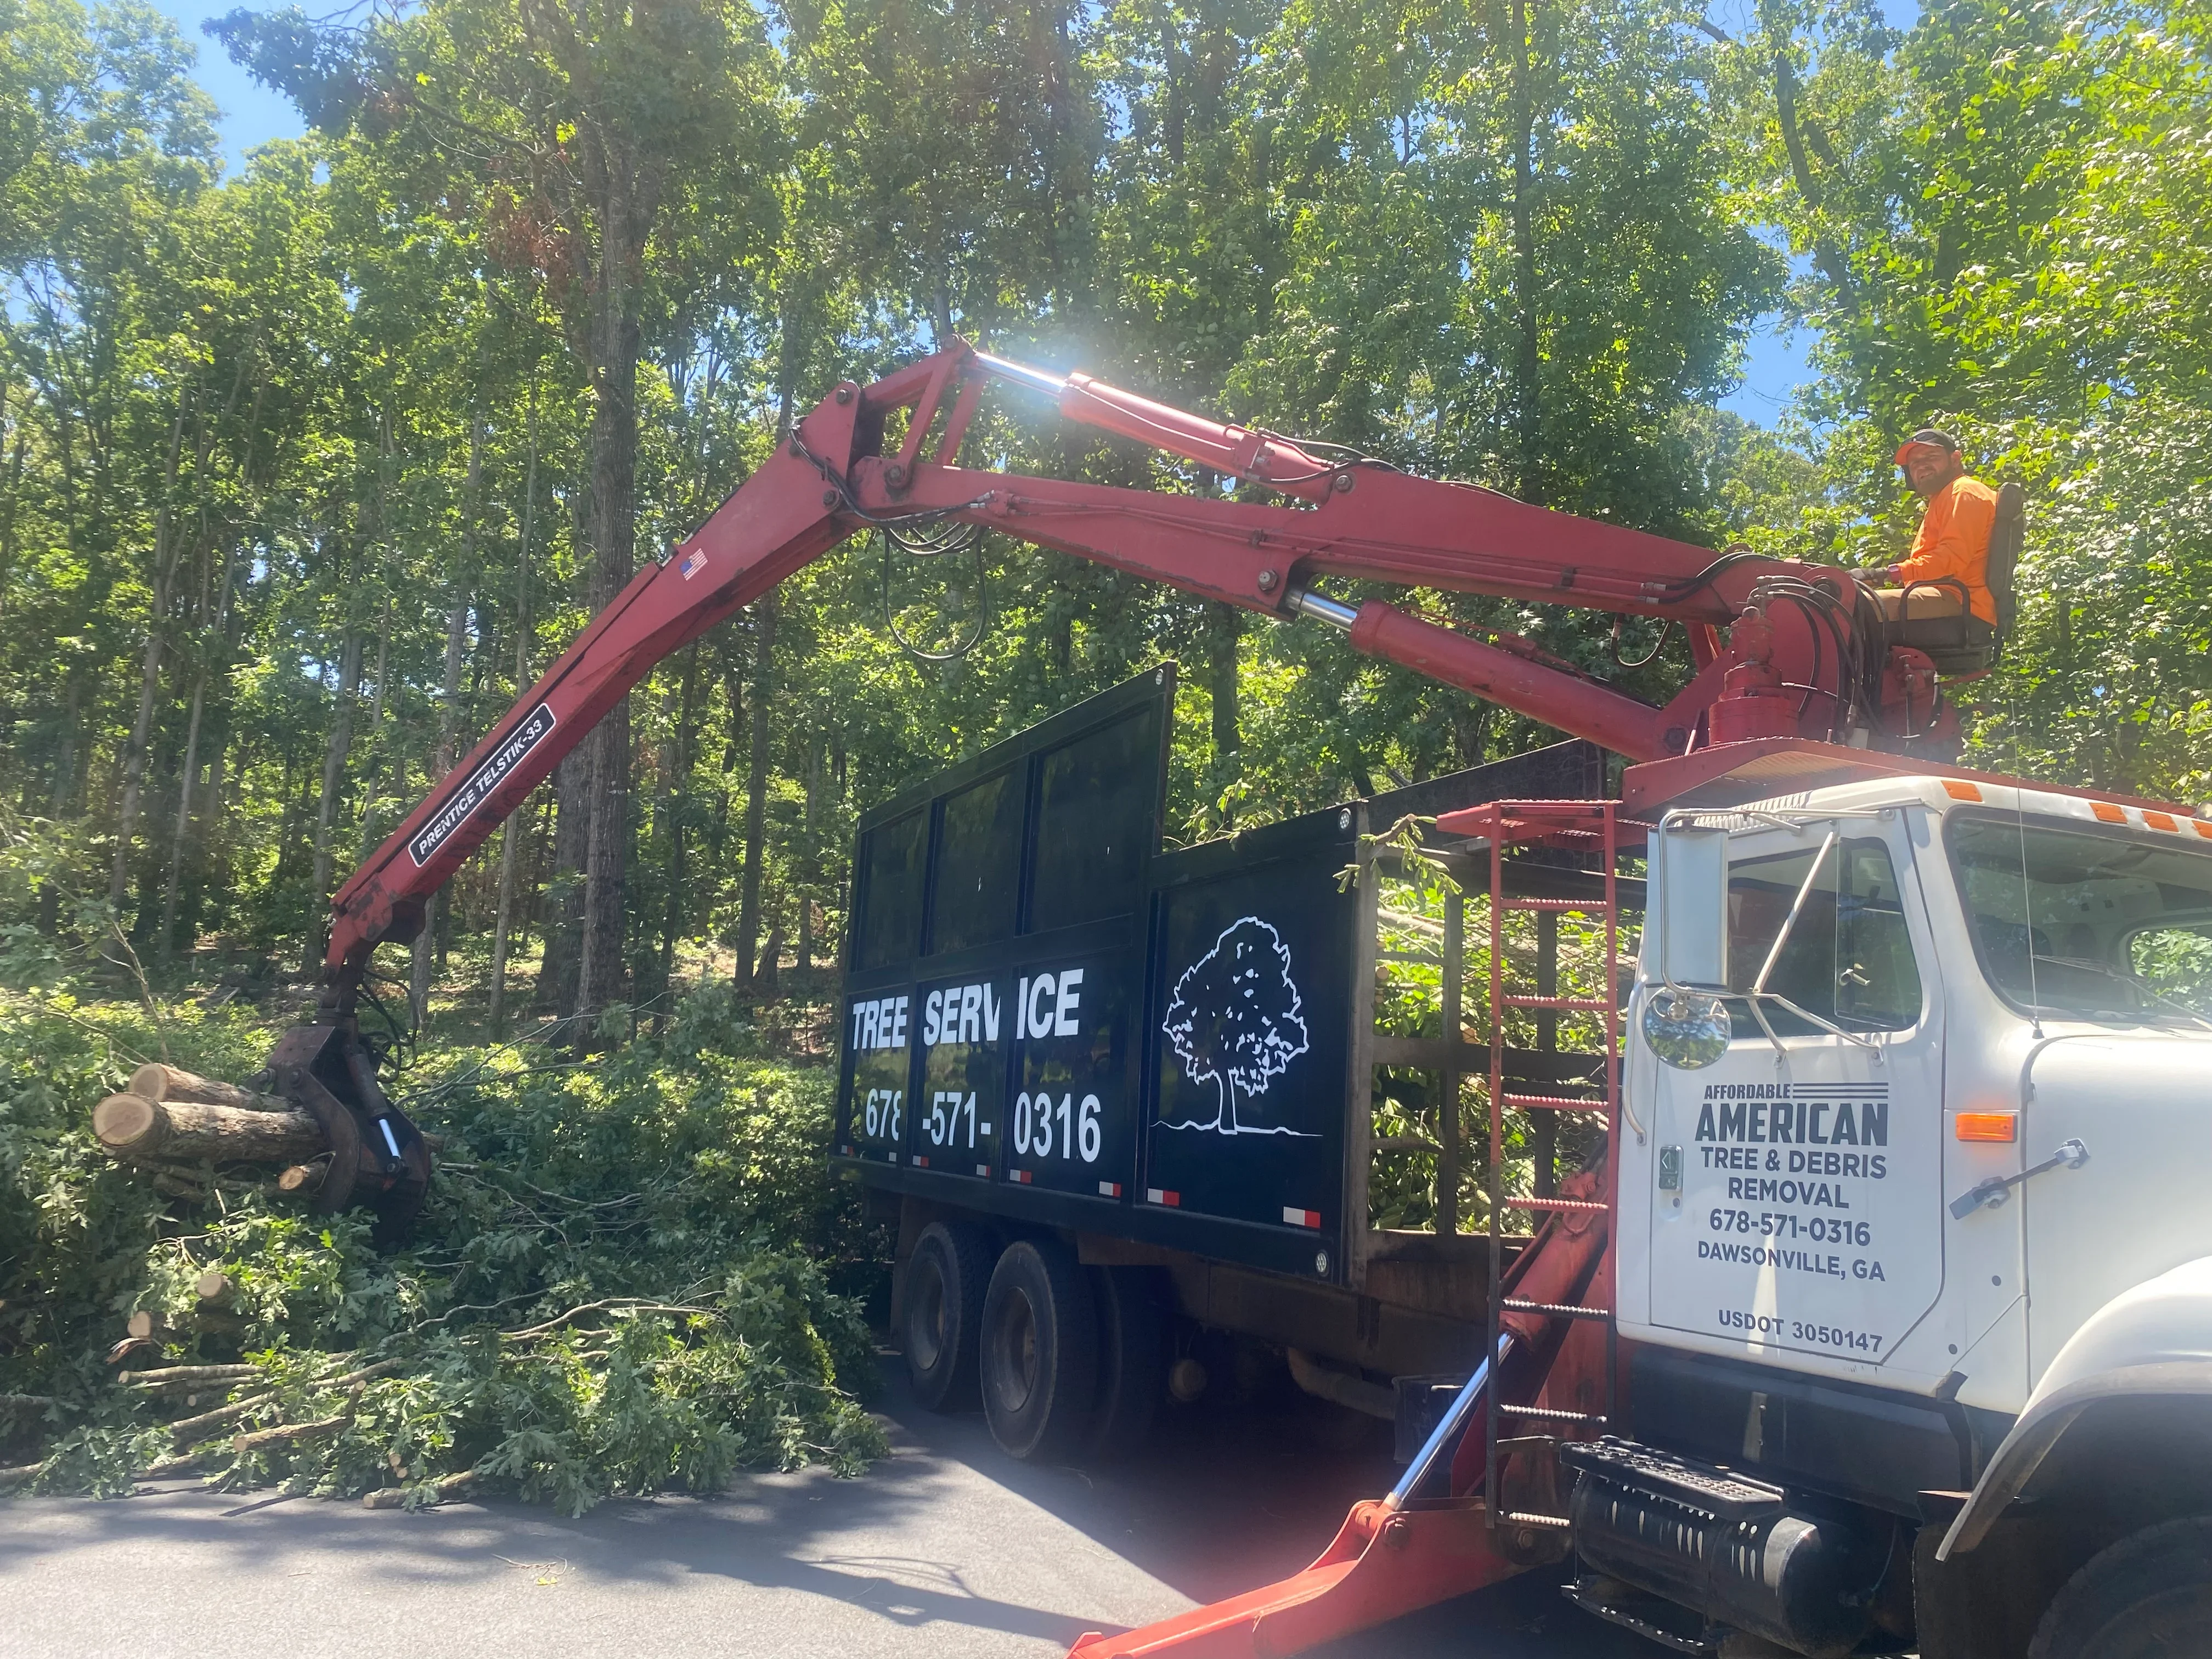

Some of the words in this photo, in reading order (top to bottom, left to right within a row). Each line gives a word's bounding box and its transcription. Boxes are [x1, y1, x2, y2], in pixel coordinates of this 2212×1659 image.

[419, 789, 476, 855] PRENTICE
[476, 719, 542, 792] TELSTIK-33
[853, 996, 909, 1049] TREE
[1704, 1084, 1791, 1099] AFFORDABLE
[1695, 1103, 1888, 1147] AMERICAN
[1701, 1147, 1758, 1170] TREE
[1765, 1149, 1780, 1172] &
[1789, 1152, 1887, 1178] DEBRIS
[1728, 1177, 1849, 1209] REMOVAL
[1709, 1209, 1870, 1246] 678-571-0316
[1698, 1241, 1846, 1280] DAWSONVILLE,
[1852, 1260, 1886, 1282] GA
[1719, 1310, 1784, 1335] USDOT
[1792, 1322, 1882, 1353] 3050147
